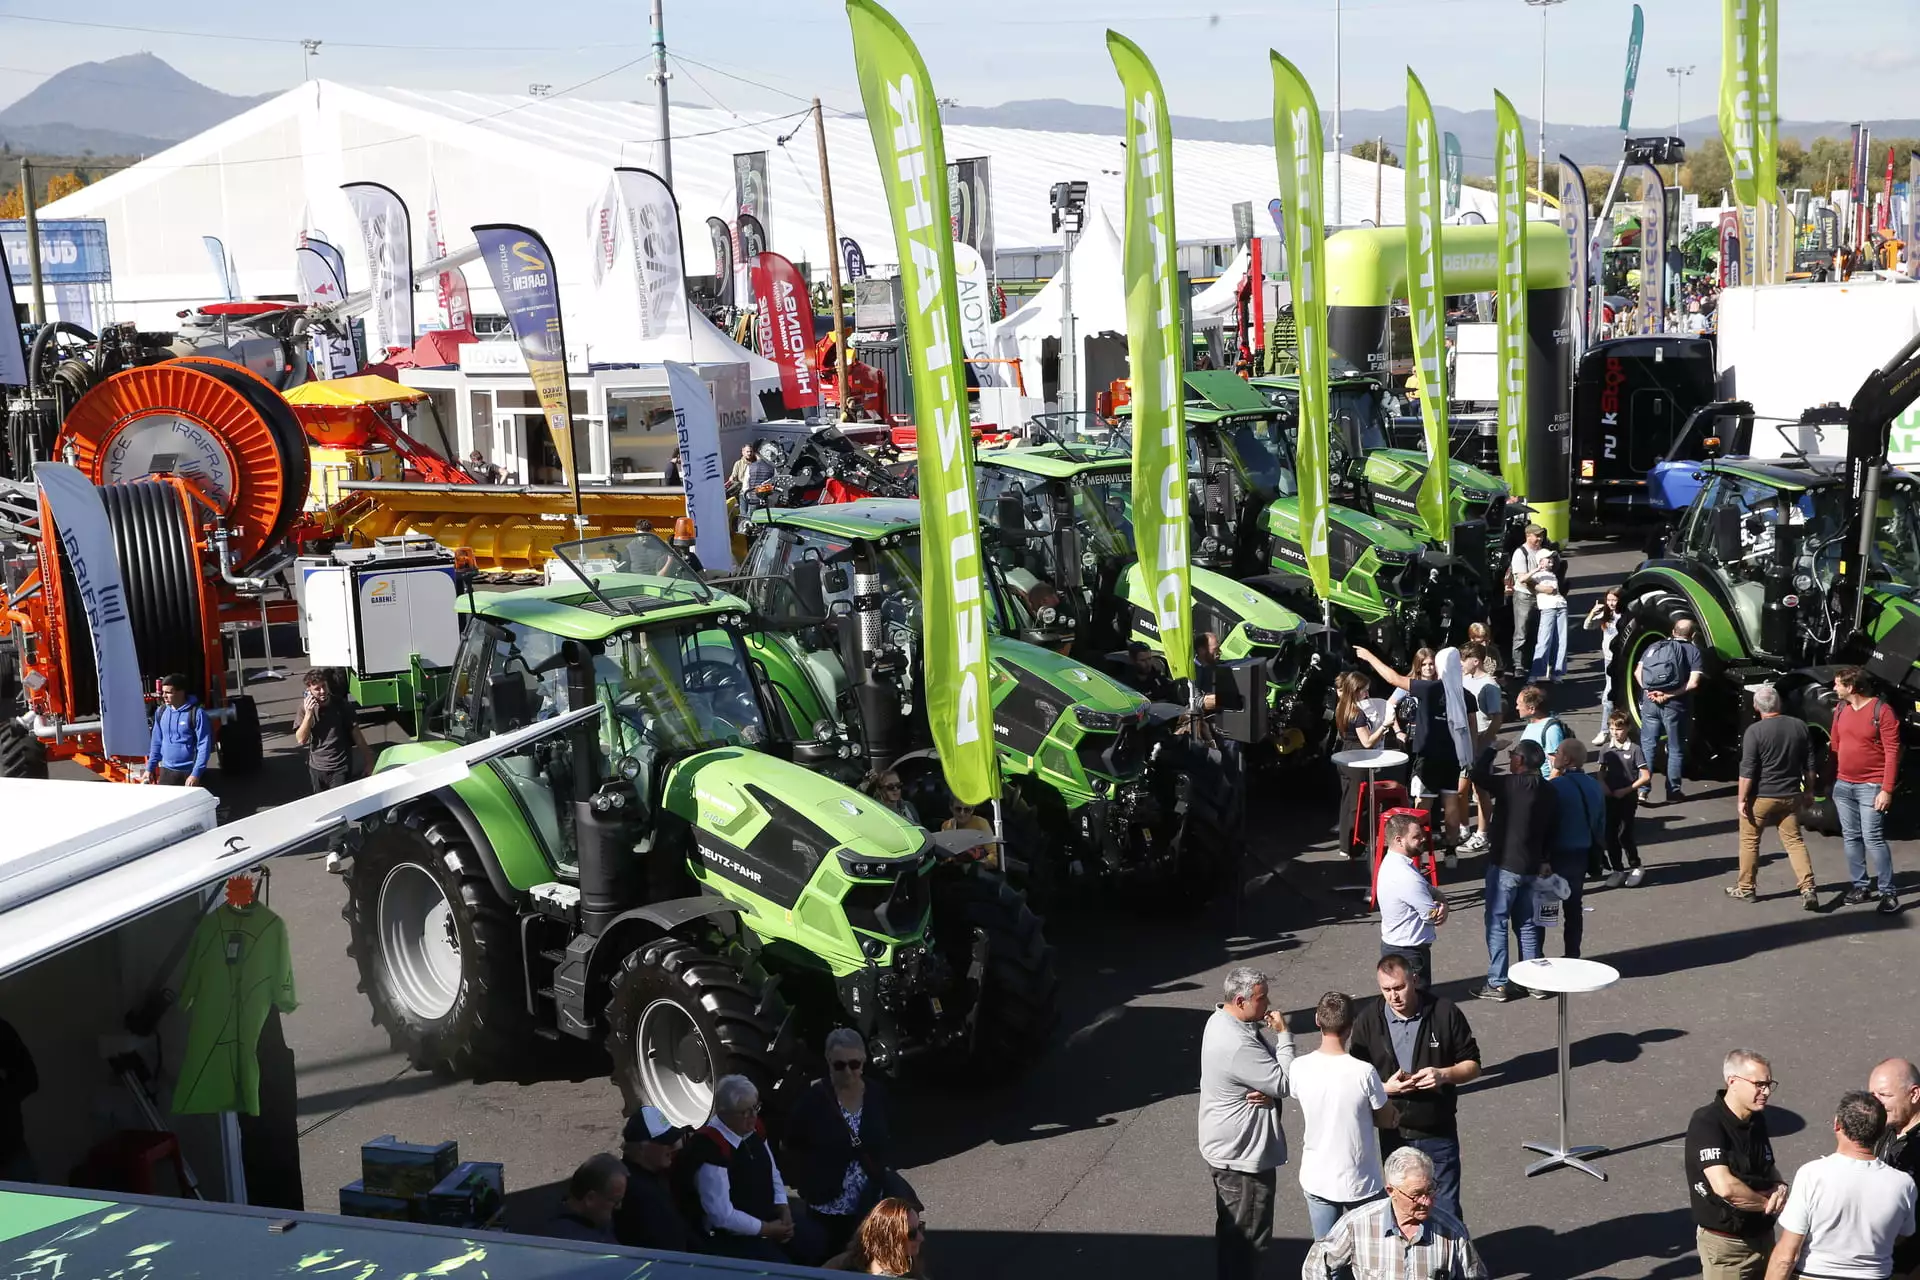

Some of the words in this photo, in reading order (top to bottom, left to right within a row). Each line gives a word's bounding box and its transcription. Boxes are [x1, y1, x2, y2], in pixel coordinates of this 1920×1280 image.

[718, 412, 748, 429] IDASS
[1375, 491, 1415, 509] DEUTZ-FAHR
[697, 844, 762, 884] DEUTZ-FAHR
[1699, 1147, 1722, 1162] STAFF
